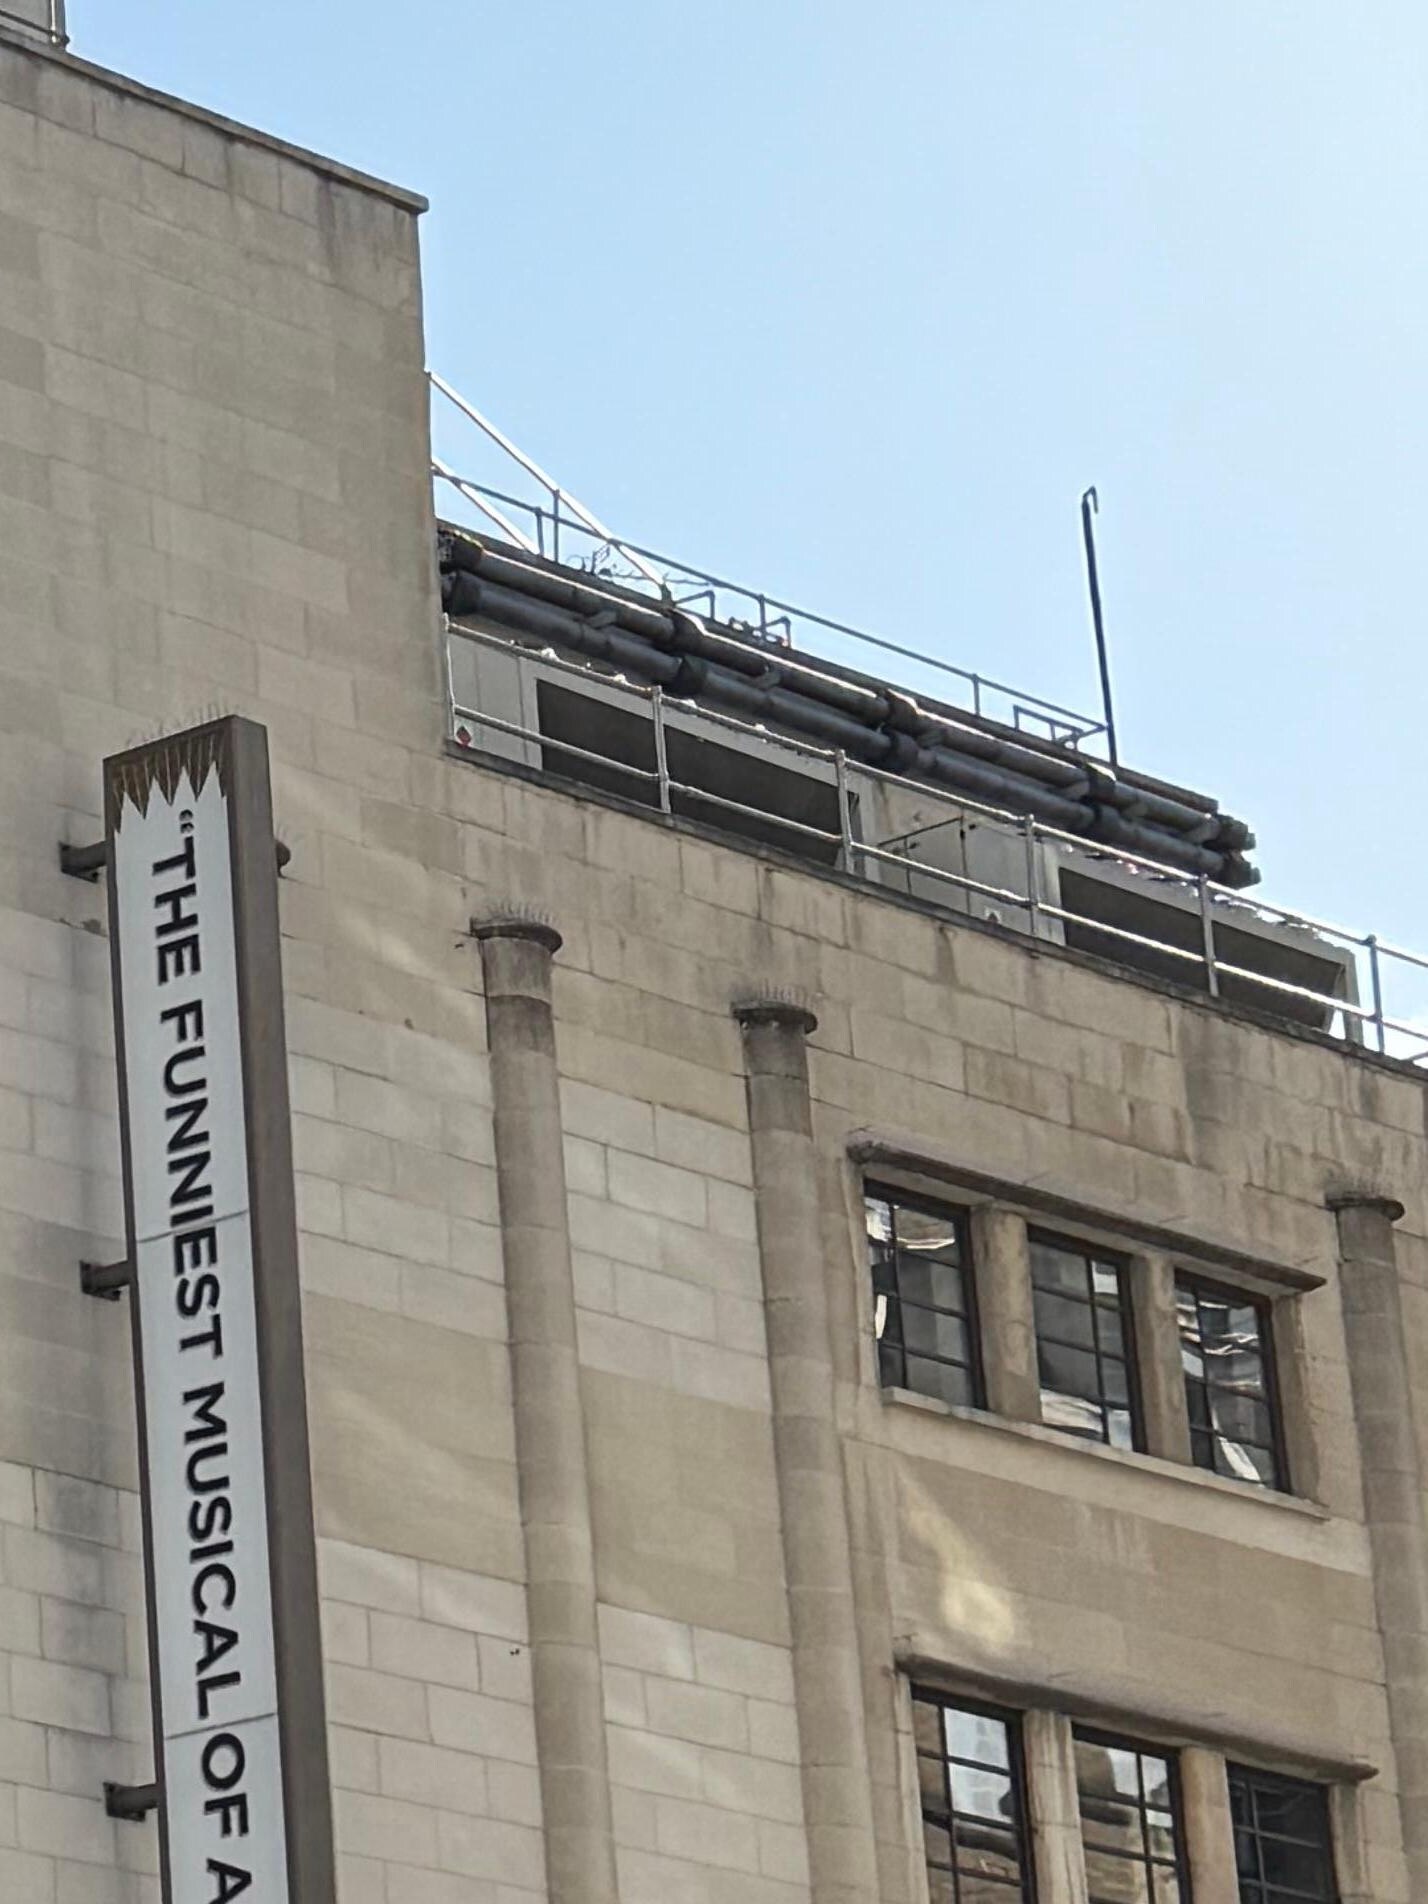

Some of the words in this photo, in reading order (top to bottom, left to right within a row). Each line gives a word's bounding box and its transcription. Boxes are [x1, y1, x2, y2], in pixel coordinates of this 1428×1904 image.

[158, 998, 224, 1362] FUNNIEST
[181, 1378, 238, 1721] MUSICAL
[199, 1733, 251, 1839] OF
